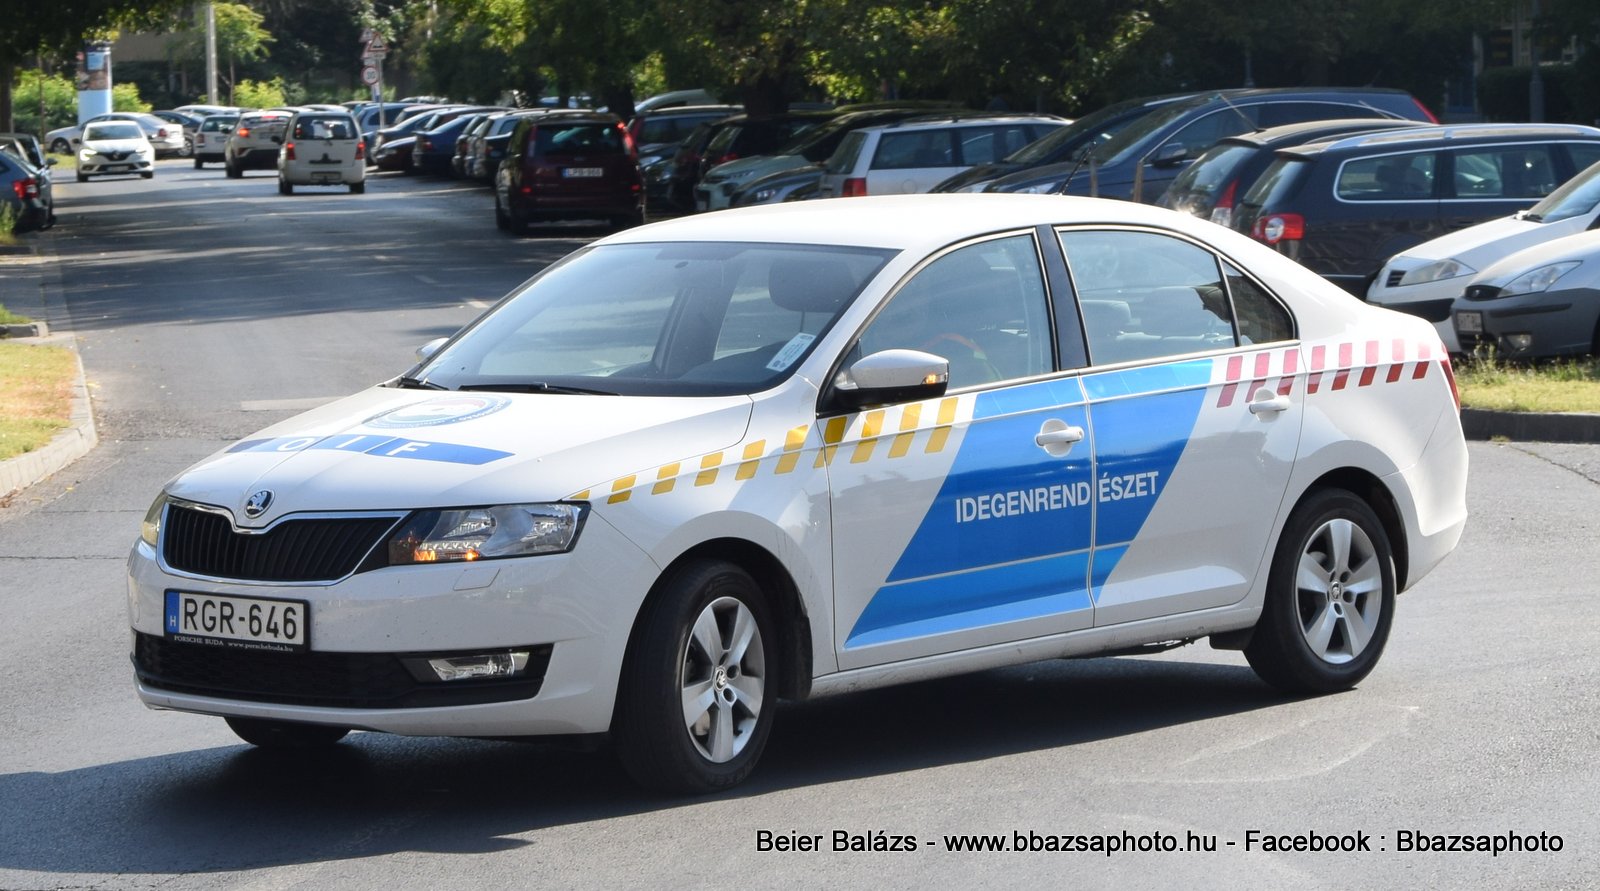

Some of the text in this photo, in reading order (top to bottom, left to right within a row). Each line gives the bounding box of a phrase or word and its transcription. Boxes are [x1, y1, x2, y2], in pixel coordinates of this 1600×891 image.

[169, 615, 177, 627] H
[184, 597, 297, 640] RGR-646
[174, 634, 203, 644] PORSCHE
[205, 638, 224, 646] BUDA
